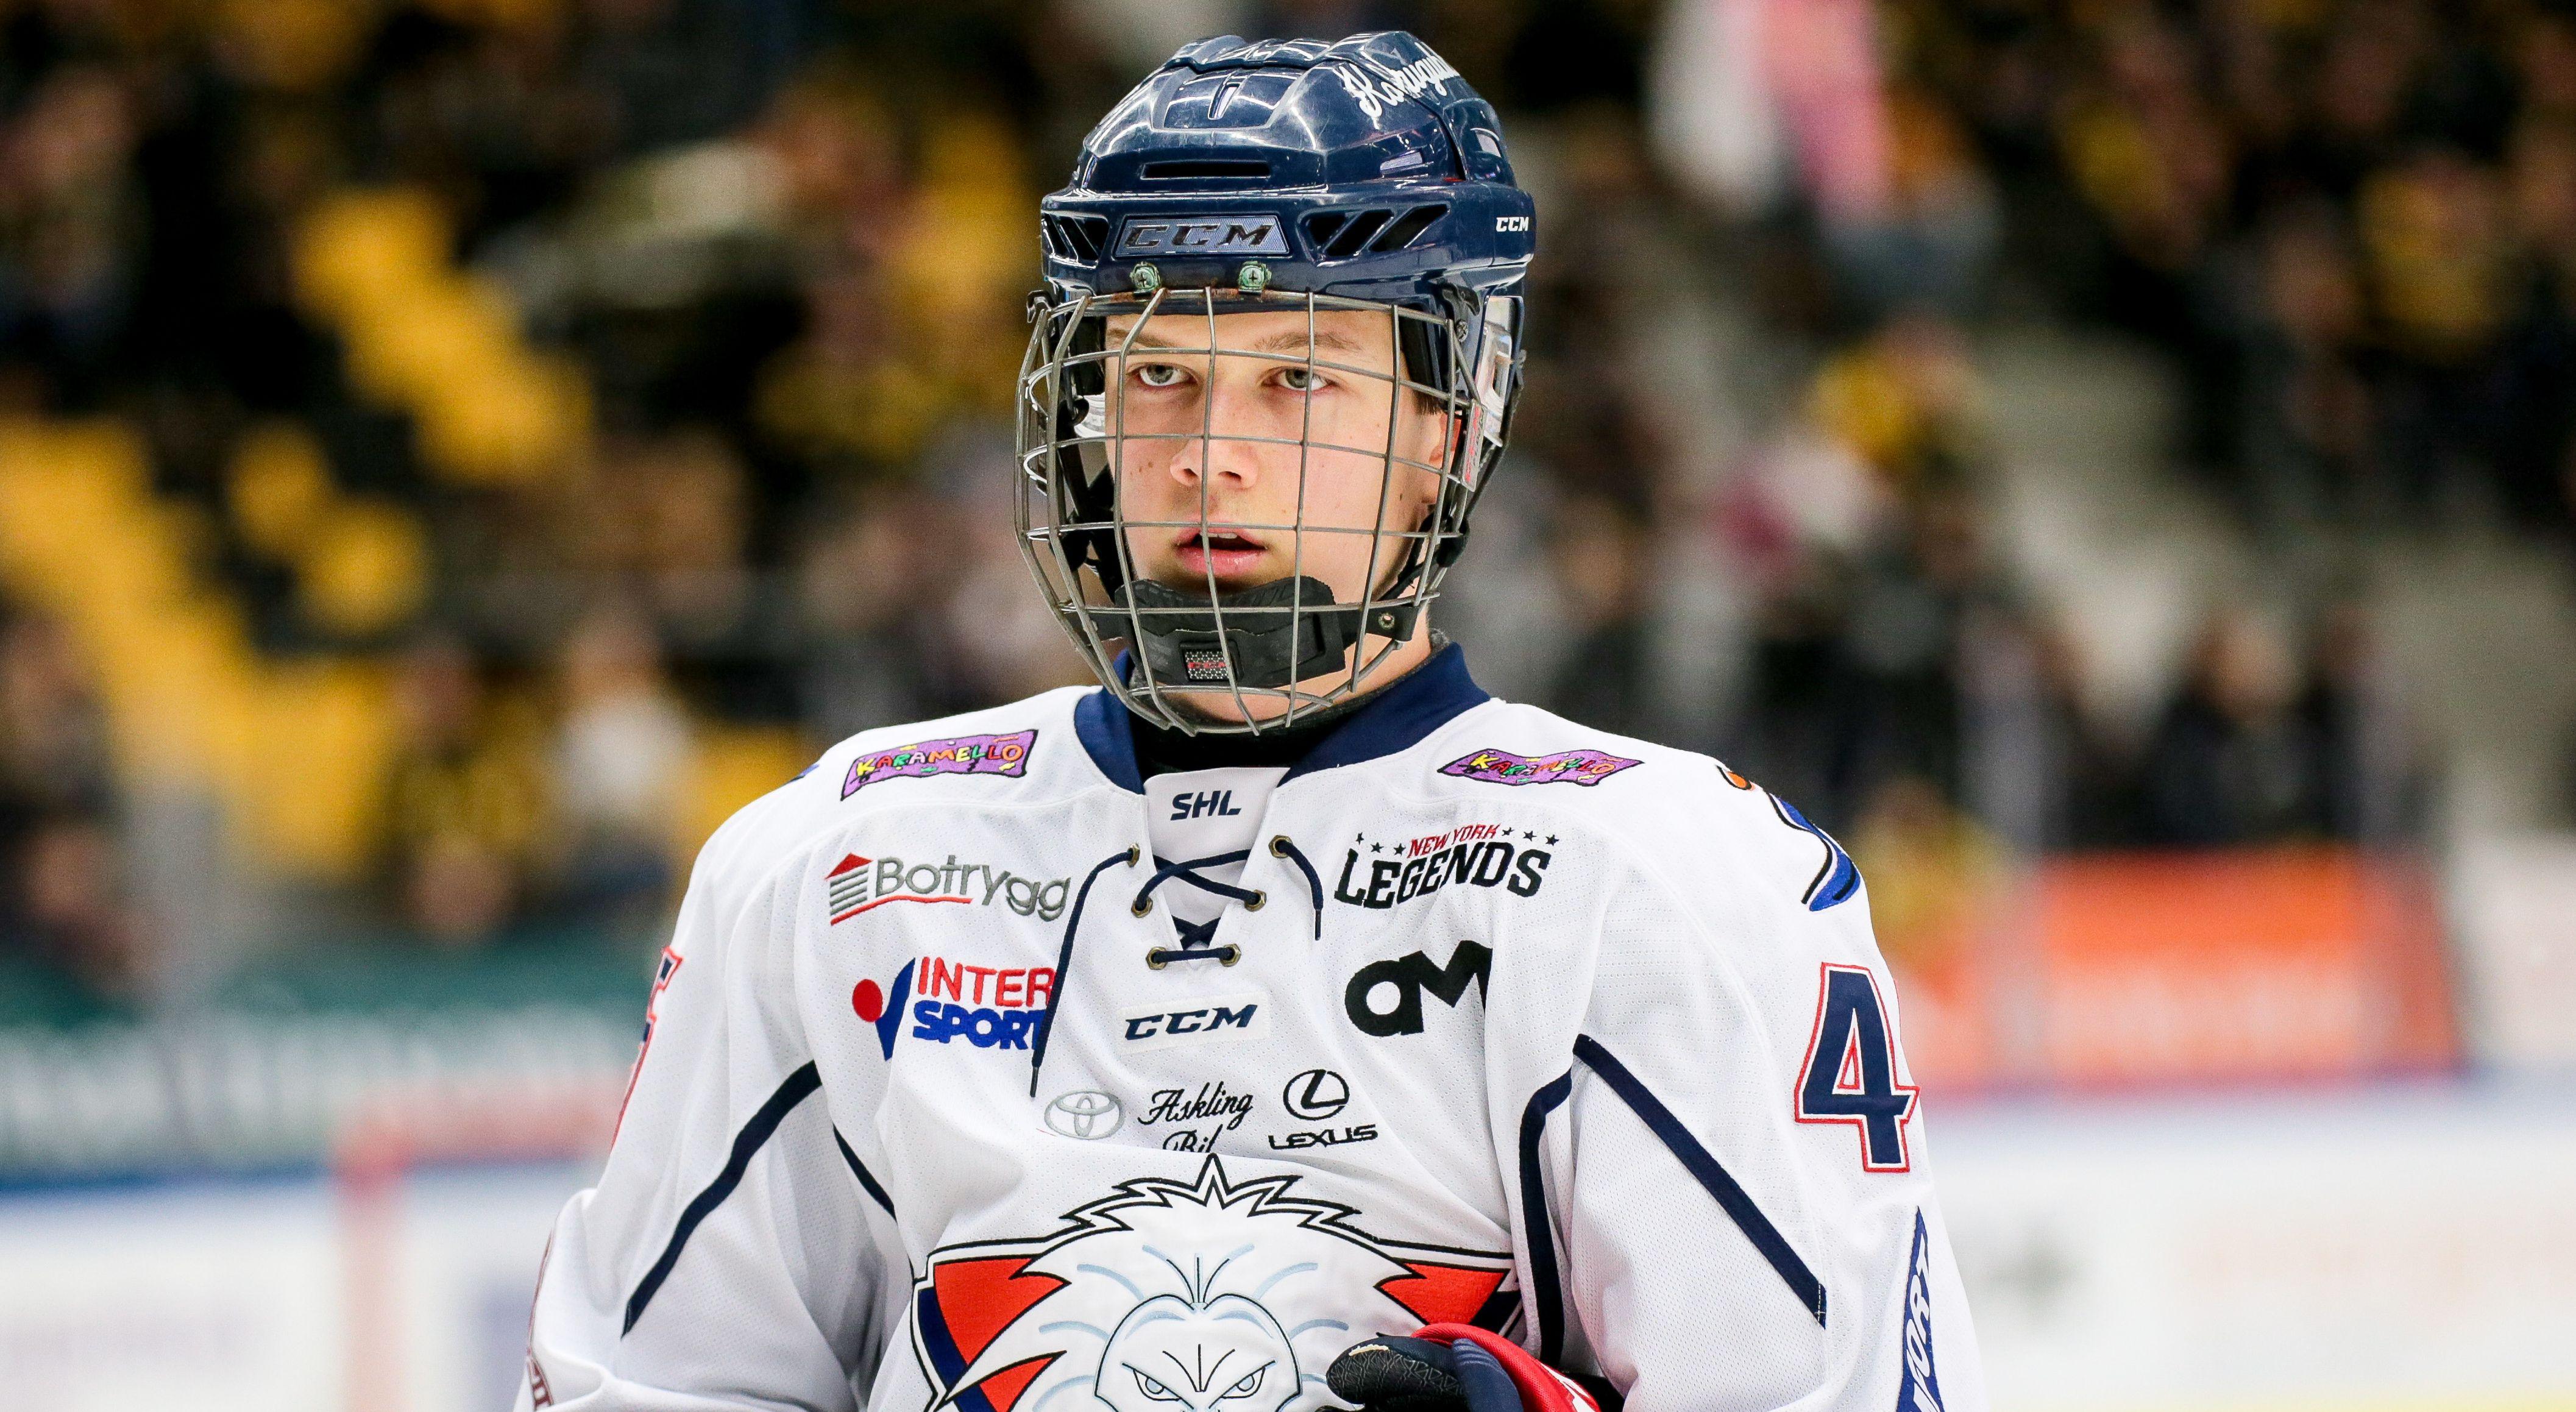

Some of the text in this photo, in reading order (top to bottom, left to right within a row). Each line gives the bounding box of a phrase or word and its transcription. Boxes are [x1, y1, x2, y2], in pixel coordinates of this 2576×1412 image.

[1125, 223, 1275, 249] CCM
[1496, 216, 1529, 232] CCM
[856, 745, 1024, 776] KARAMELLO
[1170, 790, 1241, 821] SHL
[1407, 823, 1501, 858] NEW YORK
[875, 854, 1071, 921] Botrygg
[1334, 841, 1552, 909] LEGENDS
[918, 956, 1056, 1008] INTER
[1124, 1004, 1258, 1041] CCM
[1794, 961, 1920, 1173] 4
[1137, 1080, 1254, 1130] Askling
[1268, 1124, 1378, 1150] LEXUS
